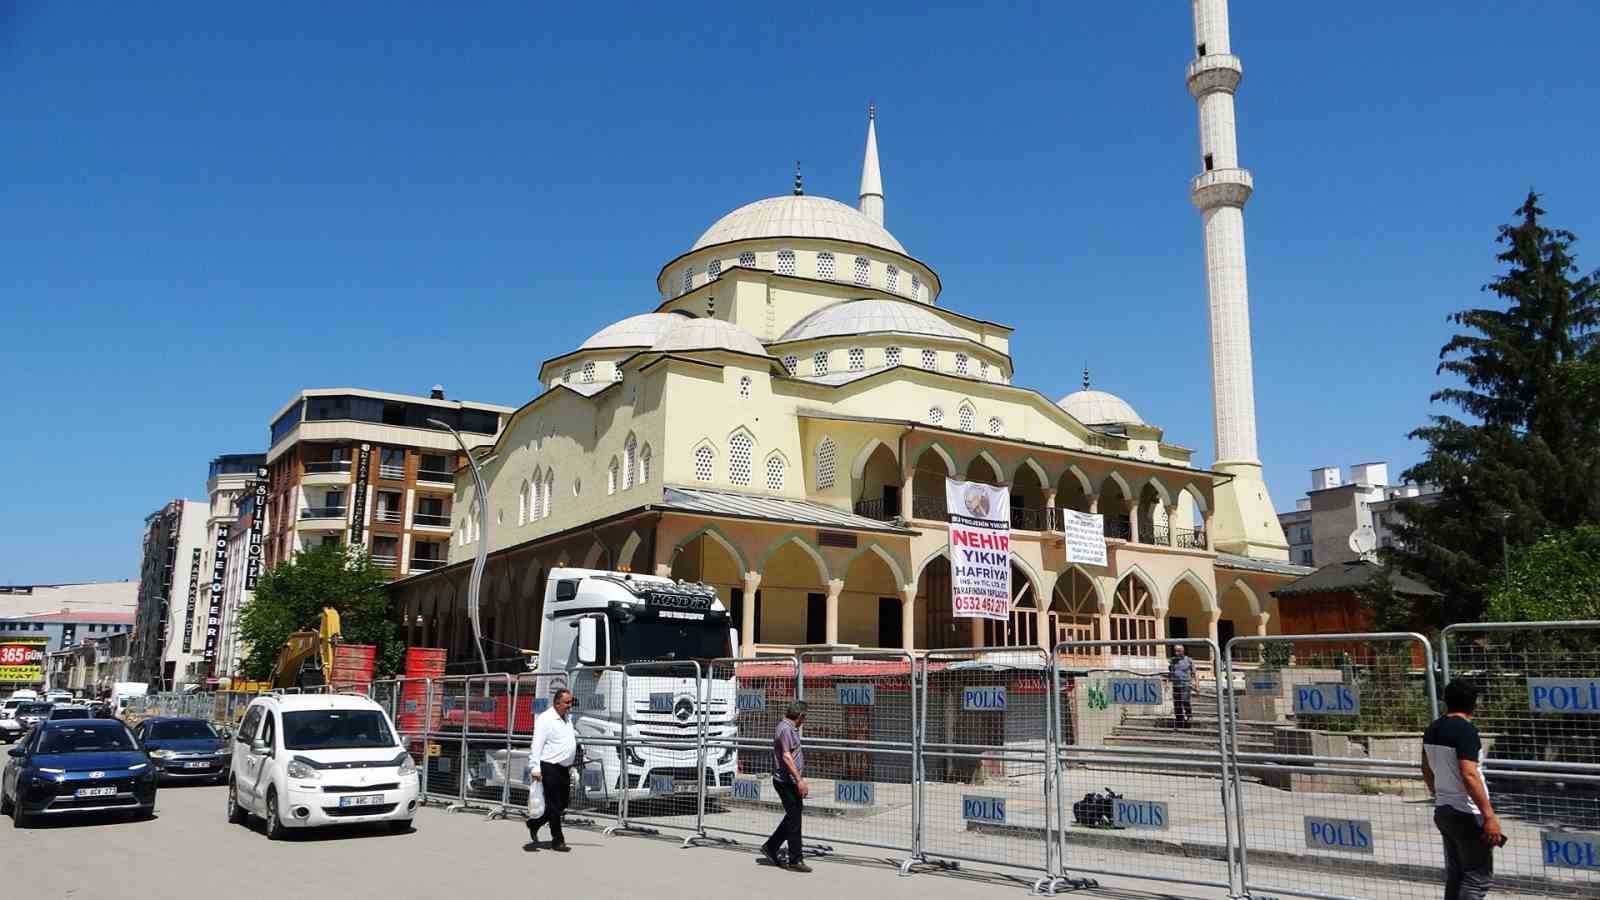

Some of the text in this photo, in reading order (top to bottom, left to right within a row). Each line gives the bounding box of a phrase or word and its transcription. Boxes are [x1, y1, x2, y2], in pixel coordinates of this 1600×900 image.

[953, 529, 1008, 550] NEHİR
[249, 534, 261, 587] HOTEL
[962, 549, 1006, 567] YIKIM
[955, 597, 980, 610] 0532
[1, 648, 25, 662] 365
[965, 687, 1004, 708] POLİS
[1113, 679, 1157, 704] POLİS
[965, 796, 1004, 820] POLİS
[1118, 801, 1163, 827] POLİS
[1311, 820, 1369, 849] POLİS
